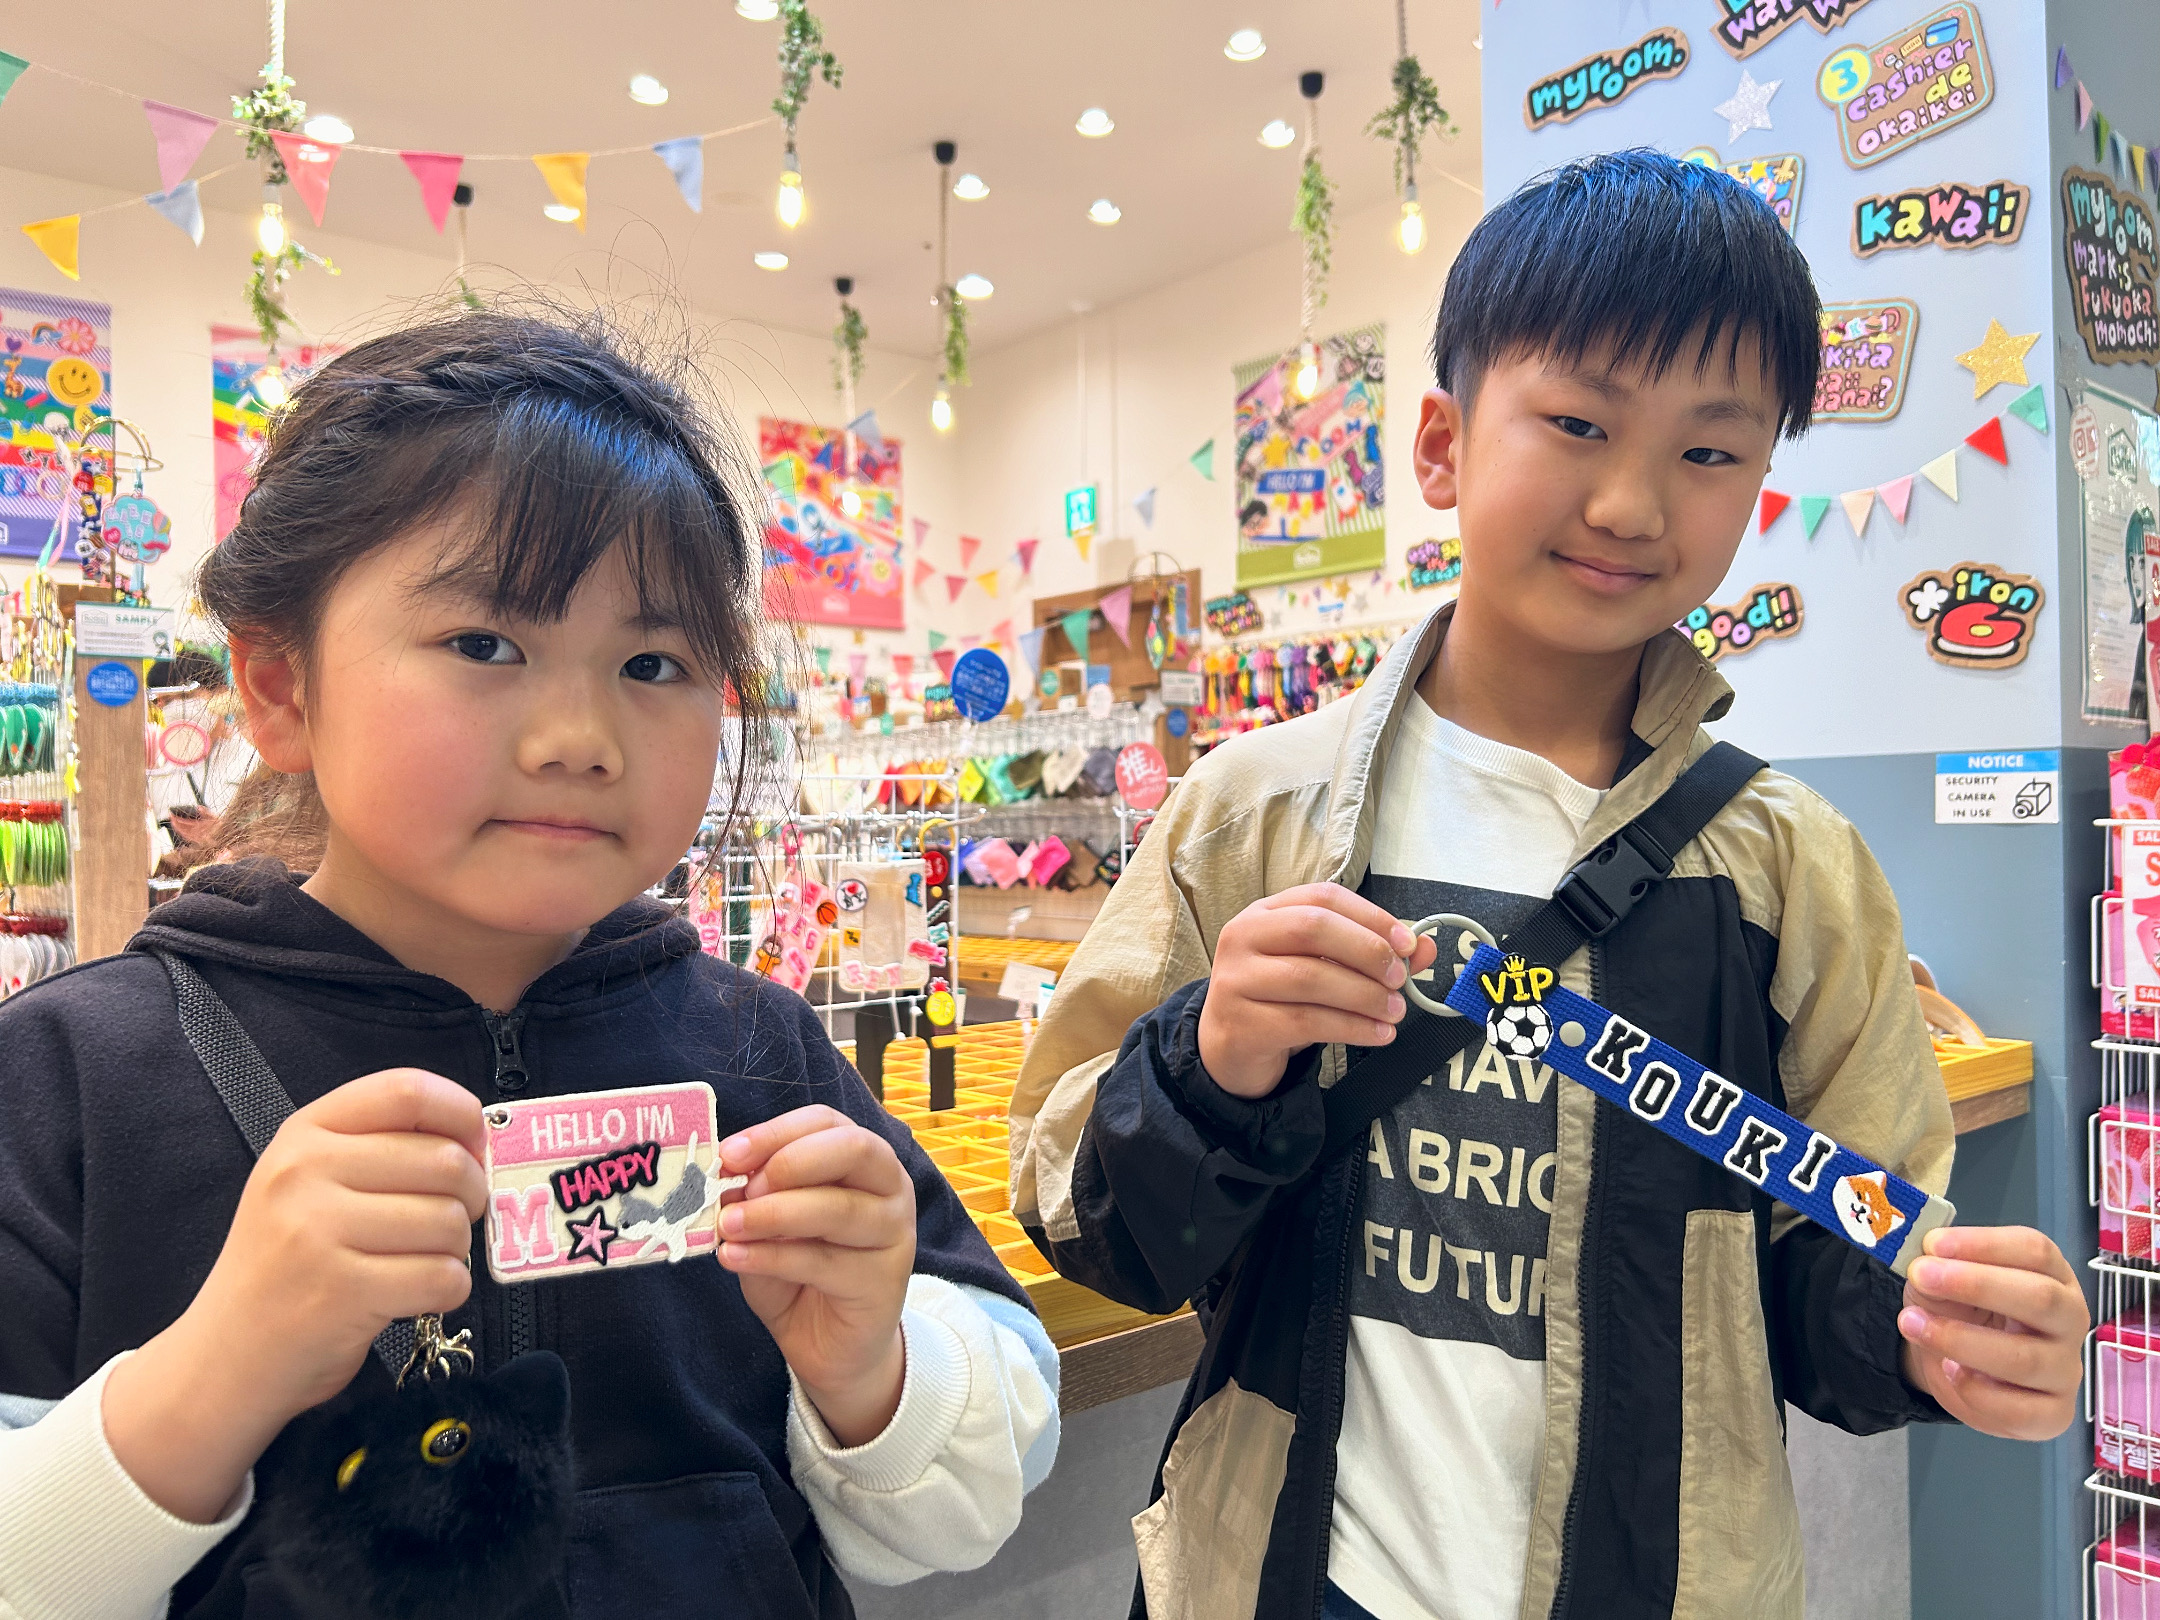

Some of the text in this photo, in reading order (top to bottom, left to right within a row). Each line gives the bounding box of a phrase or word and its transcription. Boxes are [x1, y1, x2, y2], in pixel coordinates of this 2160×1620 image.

[1830, 59, 1859, 96] 3
[1847, 39, 1973, 121] cashier
[1926, 63, 1973, 104] de
[1858, 84, 1976, 154] okaikei
[1955, 569, 2038, 612] iron
[115, 613, 158, 625] SAMPLE
[1118, 746, 1162, 787] 推し
[1945, 775, 1999, 786] SECURITY
[1967, 754, 2024, 769] NOTICE
[1947, 792, 1997, 802] CAMERA
[1952, 808, 1992, 818] IN USE
[1481, 966, 1555, 1006] VIP
[1589, 1016, 1835, 1189] KOUKI
[531, 1103, 675, 1152] HELLO I'M
[559, 1145, 655, 1207] HAPPY
[494, 1187, 556, 1267] M
